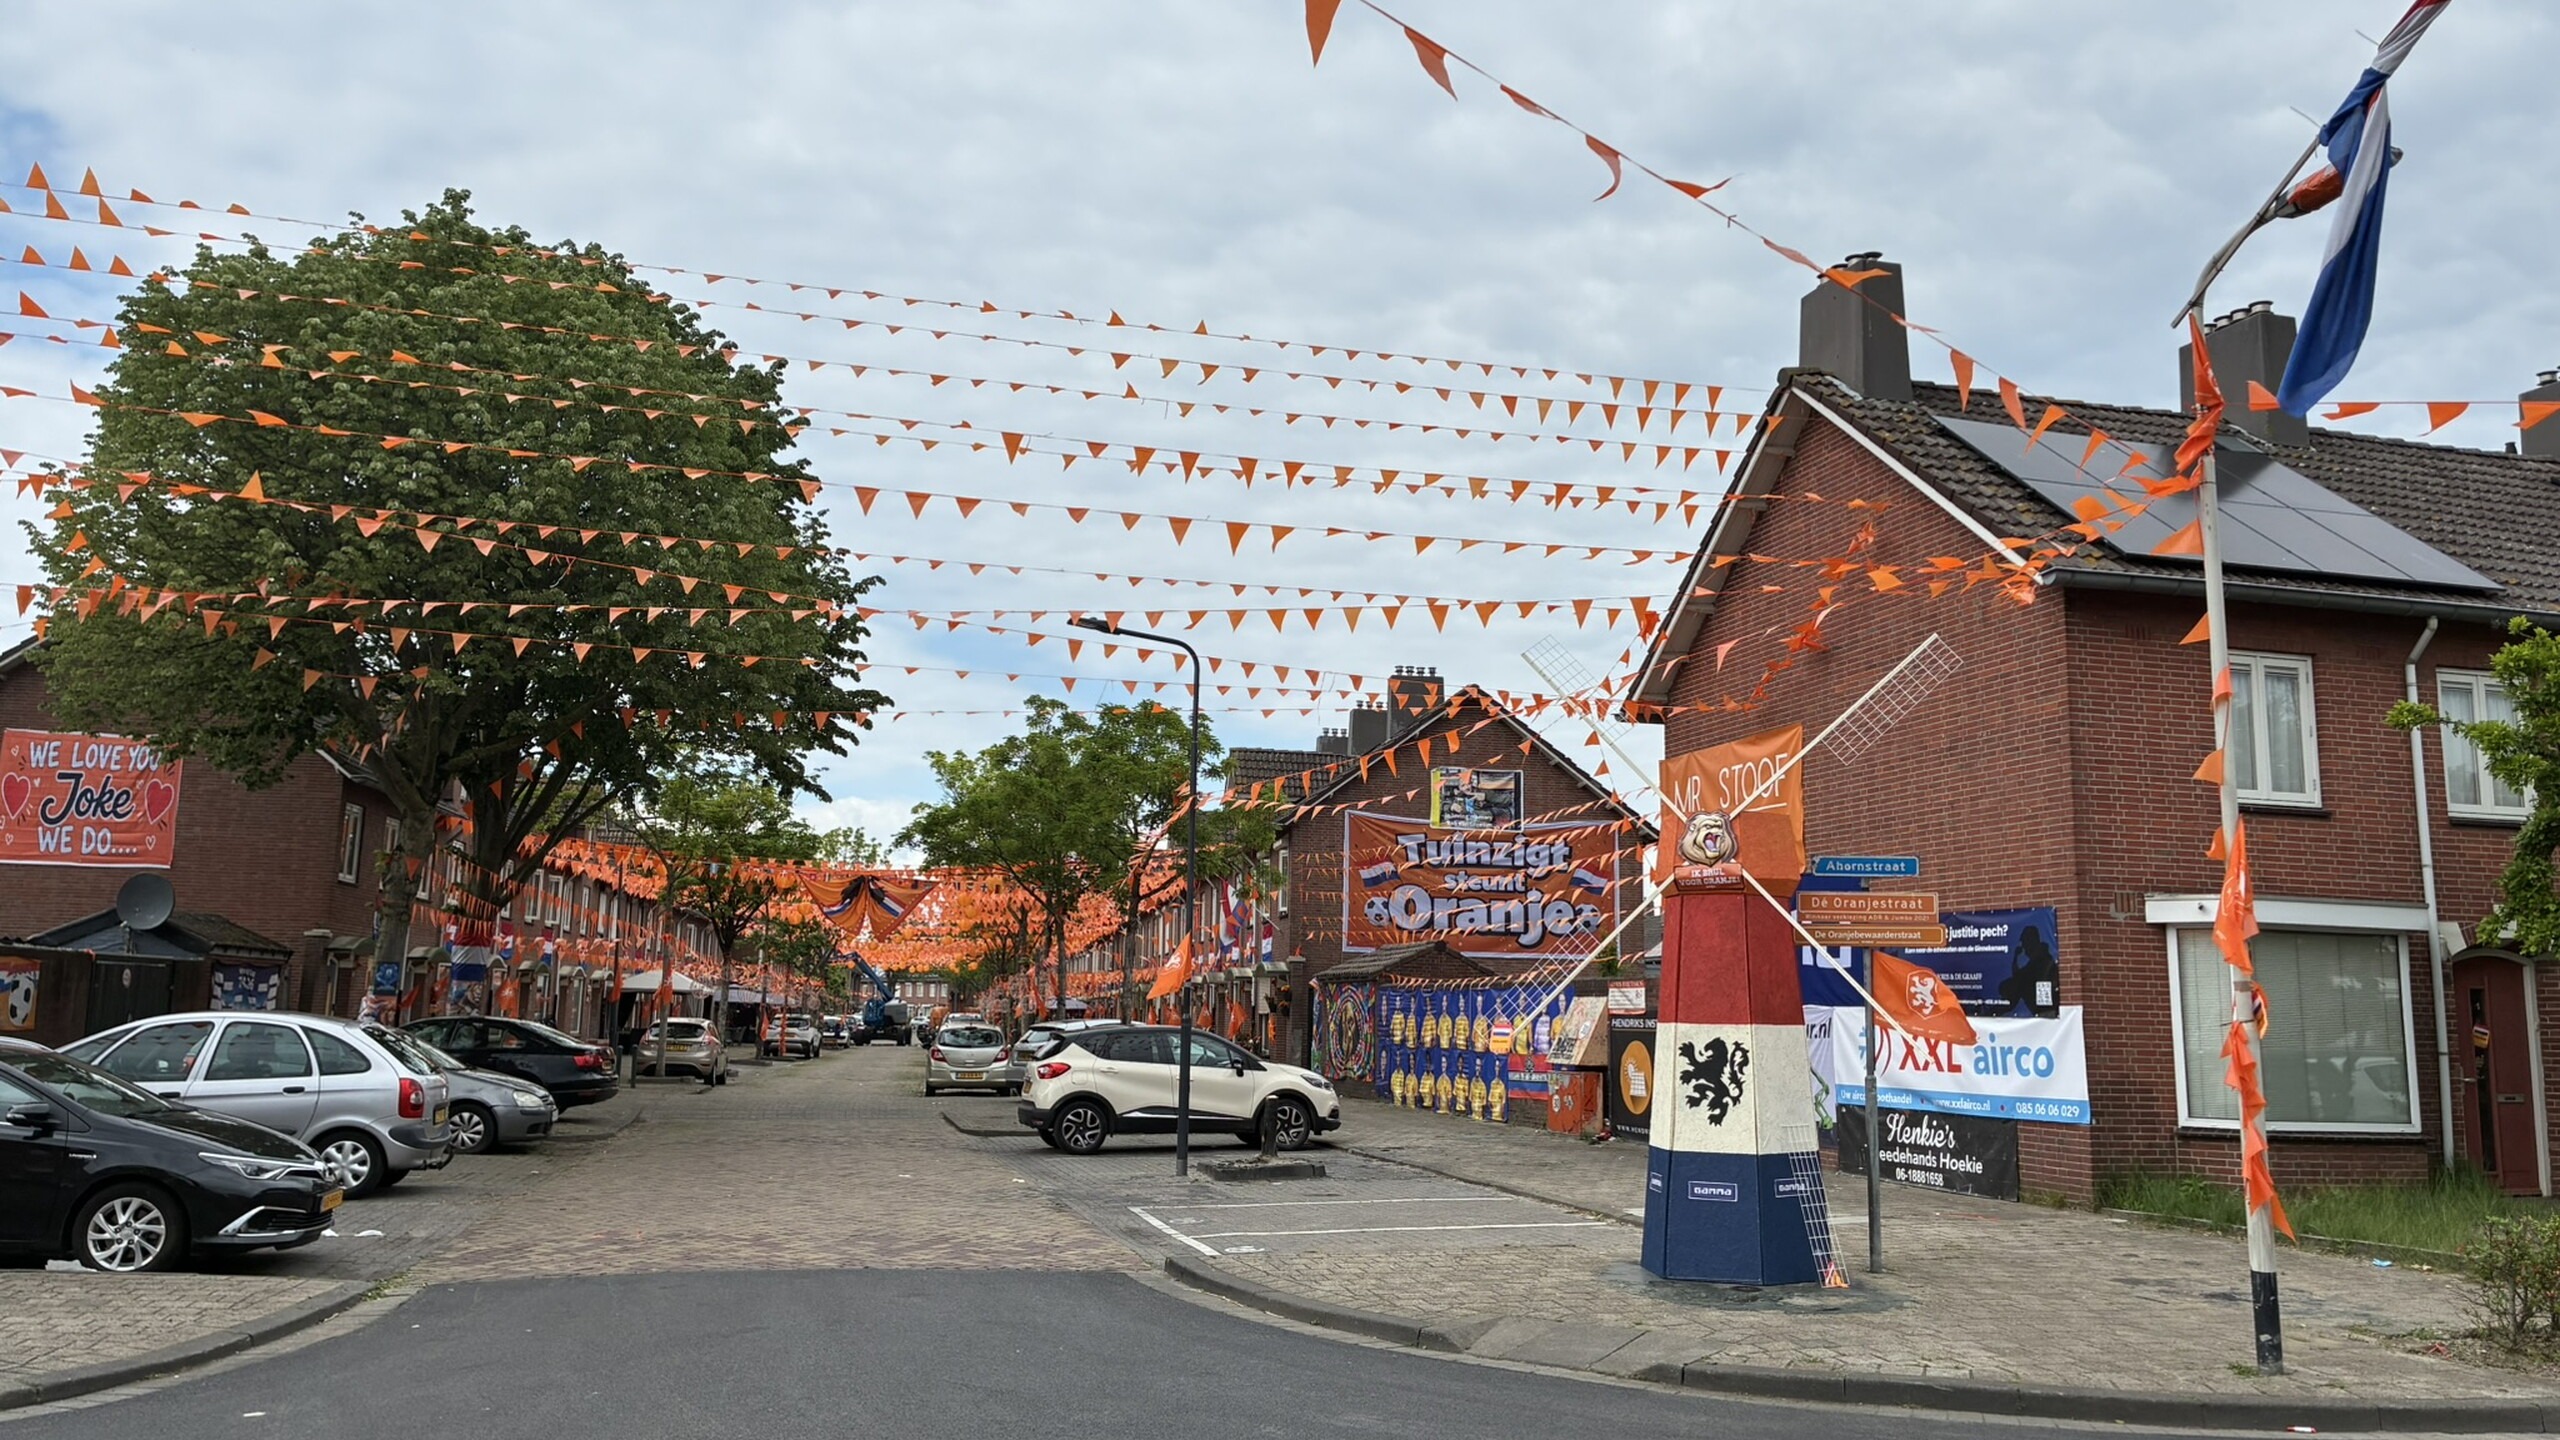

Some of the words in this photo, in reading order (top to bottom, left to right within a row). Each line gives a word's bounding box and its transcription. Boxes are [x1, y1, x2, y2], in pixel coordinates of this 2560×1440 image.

[30, 741, 61, 768] WE
[72, 742, 124, 771] LOVE
[128, 744, 162, 772] YOU
[1674, 775, 1705, 812] MR.
[1719, 752, 1788, 809] STOOF
[39, 770, 136, 827] Joke
[38, 826, 74, 853] WE
[82, 826, 138, 855] DO....
[1395, 831, 1572, 879] Tuinzigt
[1691, 869, 1701, 878] IK
[1826, 861, 1906, 872] Ahornstraat
[1443, 871, 1527, 893] steunt
[1679, 878, 1703, 886] VOOR
[1388, 884, 1575, 946] Oranje
[1833, 897, 1923, 911] Oranjestraat
[1814, 930, 1827, 939] De
[1827, 930, 1921, 941] Oranjebewaarderstraat
[1948, 926, 1979, 942] justitie
[1980, 924, 2008, 941] pech?
[1611, 1018, 1643, 1028] HENDRIKS
[1899, 1033, 1962, 1073] XXL
[1973, 1032, 2055, 1078] airco
[2016, 1103, 2033, 1114] 085
[2035, 1105, 2046, 1115] 06
[2048, 1106, 2059, 1116] 06
[2060, 1106, 2080, 1118] 029
[1886, 1112, 1956, 1149] Henkie's
[1879, 1147, 1937, 1168] eedehands
[1940, 1152, 1983, 1174] Hoekie
[1895, 1167, 1944, 1187] 06-18881658
